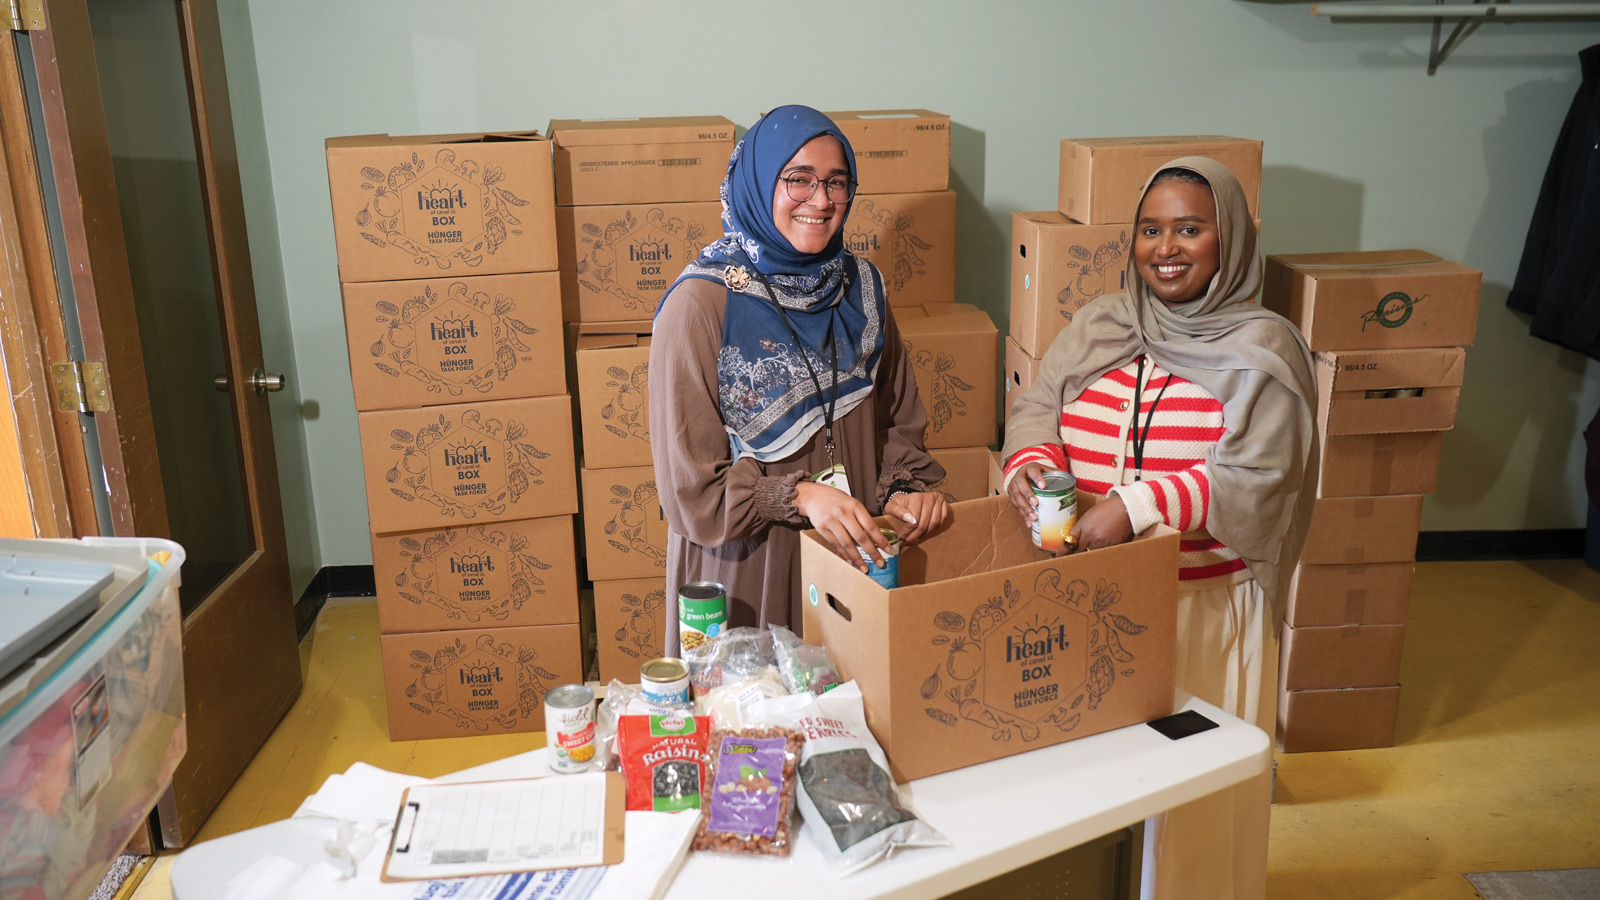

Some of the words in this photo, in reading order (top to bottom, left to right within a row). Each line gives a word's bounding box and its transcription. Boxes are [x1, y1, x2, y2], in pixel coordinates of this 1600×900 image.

[418, 190, 467, 210] heart
[432, 216, 455, 226] BOX
[630, 244, 672, 261] heart
[641, 266, 661, 275] BOX
[431, 320, 478, 340] heart
[445, 345, 467, 355] BOX
[444, 446, 491, 466] heart
[458, 470, 480, 480] BOX
[450, 556, 495, 573] heart
[463, 578, 484, 586] BOX
[686, 613, 705, 621] green
[706, 610, 723, 620] beans
[1006, 625, 1069, 662] heart
[1029, 656, 1046, 666] canal
[460, 667, 503, 684] heart
[1022, 664, 1052, 682] BOX
[472, 688, 493, 696] BOX
[1014, 699, 1032, 709] TASK
[1034, 693, 1058, 704] FORCE
[816, 716, 844, 730] SWEET
[562, 736, 586, 748] SWEET
[652, 737, 697, 751] NATURAL
[642, 744, 707, 767] Raisins
